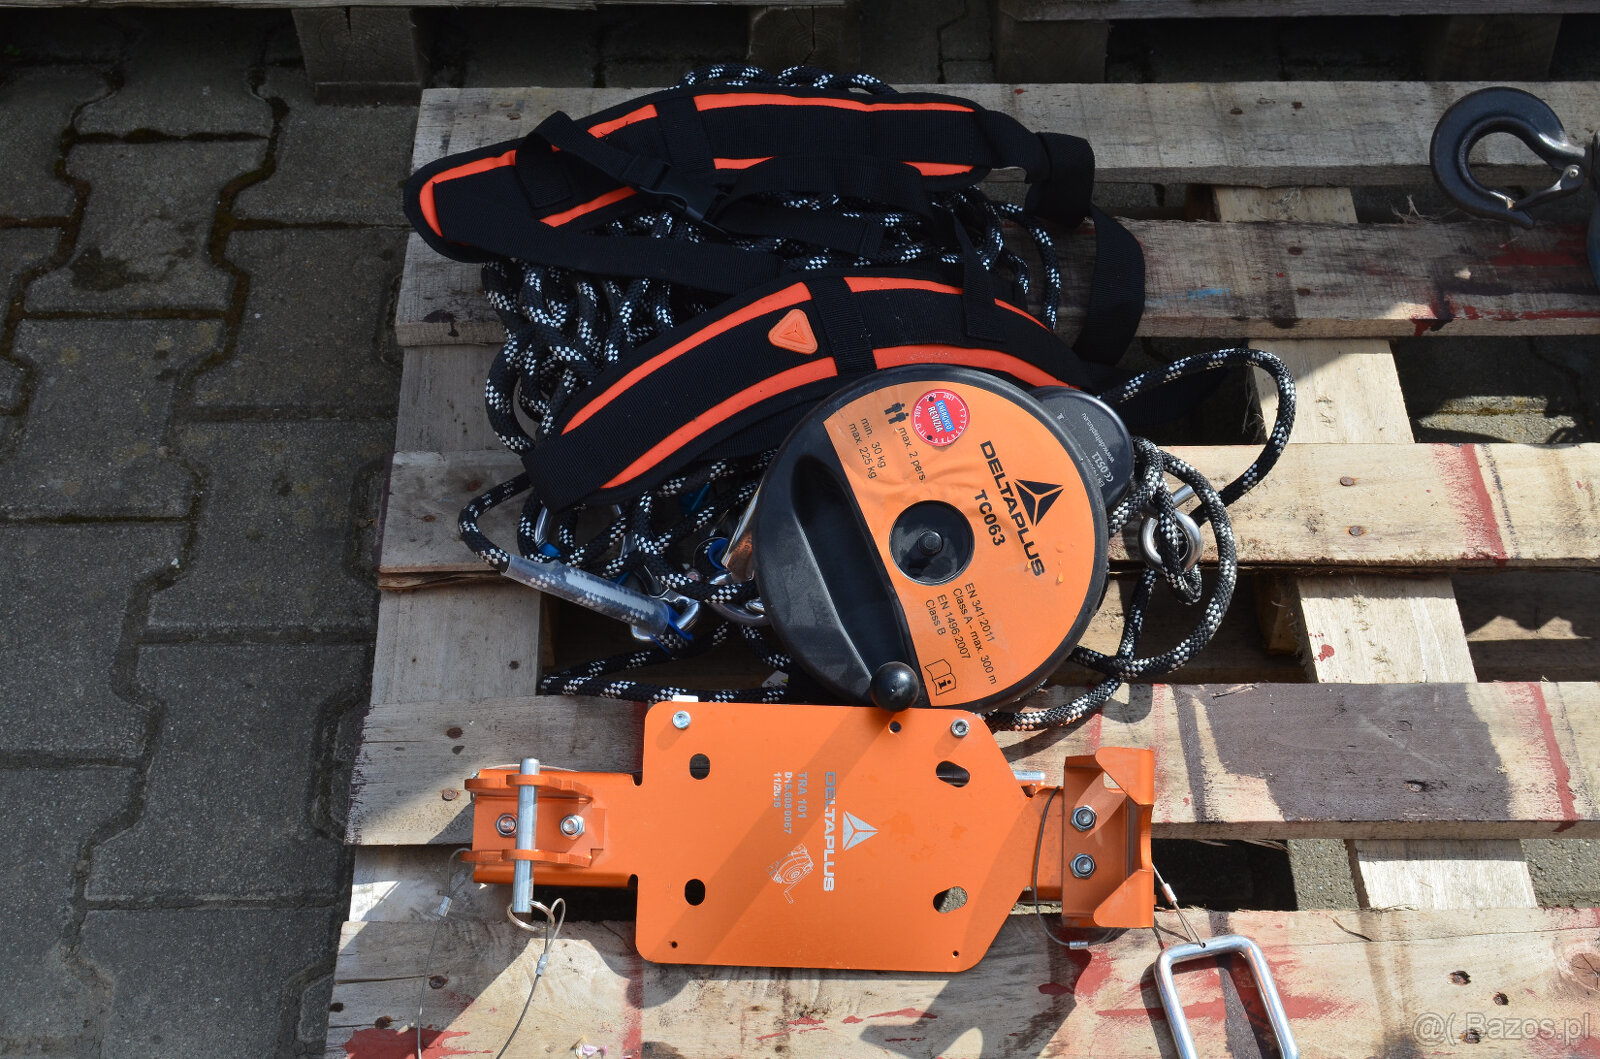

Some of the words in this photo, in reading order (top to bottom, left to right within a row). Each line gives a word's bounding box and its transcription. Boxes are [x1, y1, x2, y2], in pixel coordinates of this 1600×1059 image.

[849, 423, 863, 446] max.
[859, 447, 873, 465] 225
[867, 466, 877, 479] kg
[861, 418, 873, 438] min.
[872, 442, 882, 455] 30
[877, 455, 887, 469] kg
[899, 427, 912, 450] max.
[911, 459, 926, 483] pers.
[1091, 451, 1108, 473] 0511
[974, 489, 1006, 546] TC063
[980, 440, 1045, 577] DELTAPLUS
[926, 599, 940, 626] Class
[937, 627, 947, 635] B
[937, 594, 950, 610] EN
[945, 612, 971, 659] 1496:2007
[953, 588, 968, 615] Class
[964, 616, 973, 624] A
[970, 630, 984, 654] max.
[980, 655, 994, 674] 300
[988, 675, 997, 685] m
[964, 582, 978, 599] EN
[972, 599, 995, 642] 341:2011
[797, 799, 807, 818] 101
[798, 772, 807, 795] TRA
[823, 771, 836, 891] DELTAPLUS
